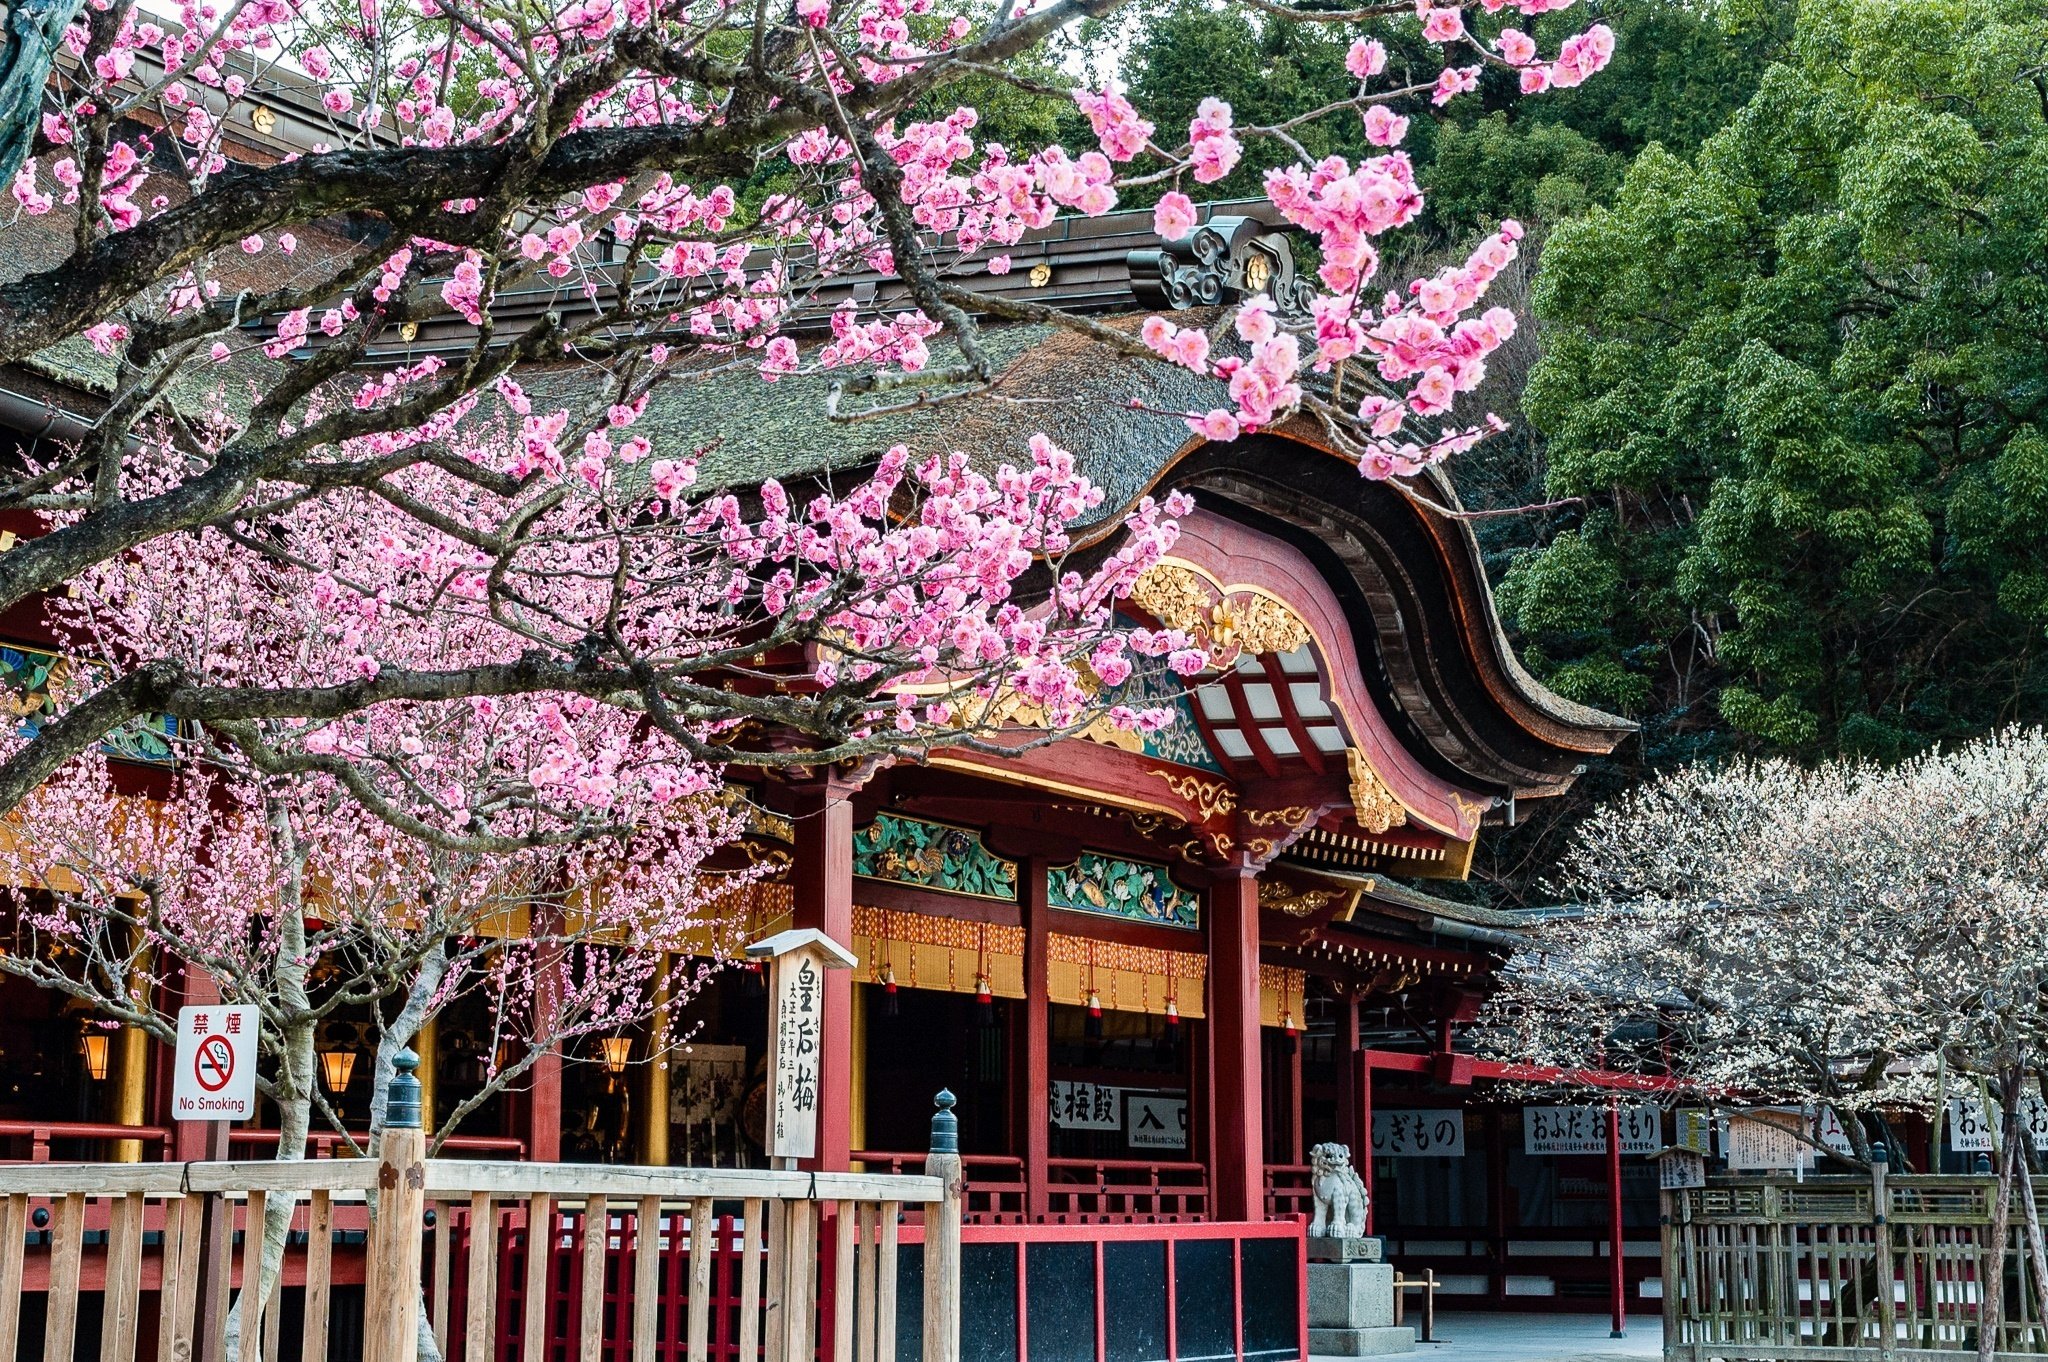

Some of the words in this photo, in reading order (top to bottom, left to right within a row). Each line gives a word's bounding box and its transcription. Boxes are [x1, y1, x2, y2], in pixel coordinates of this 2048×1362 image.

[193, 1013, 241, 1035] 禁煙
[787, 982, 797, 1092] 大正十一年三月
[792, 958, 815, 1113] 皇后梅
[180, 1097, 194, 1110] No
[198, 1097, 244, 1113] Smoking
